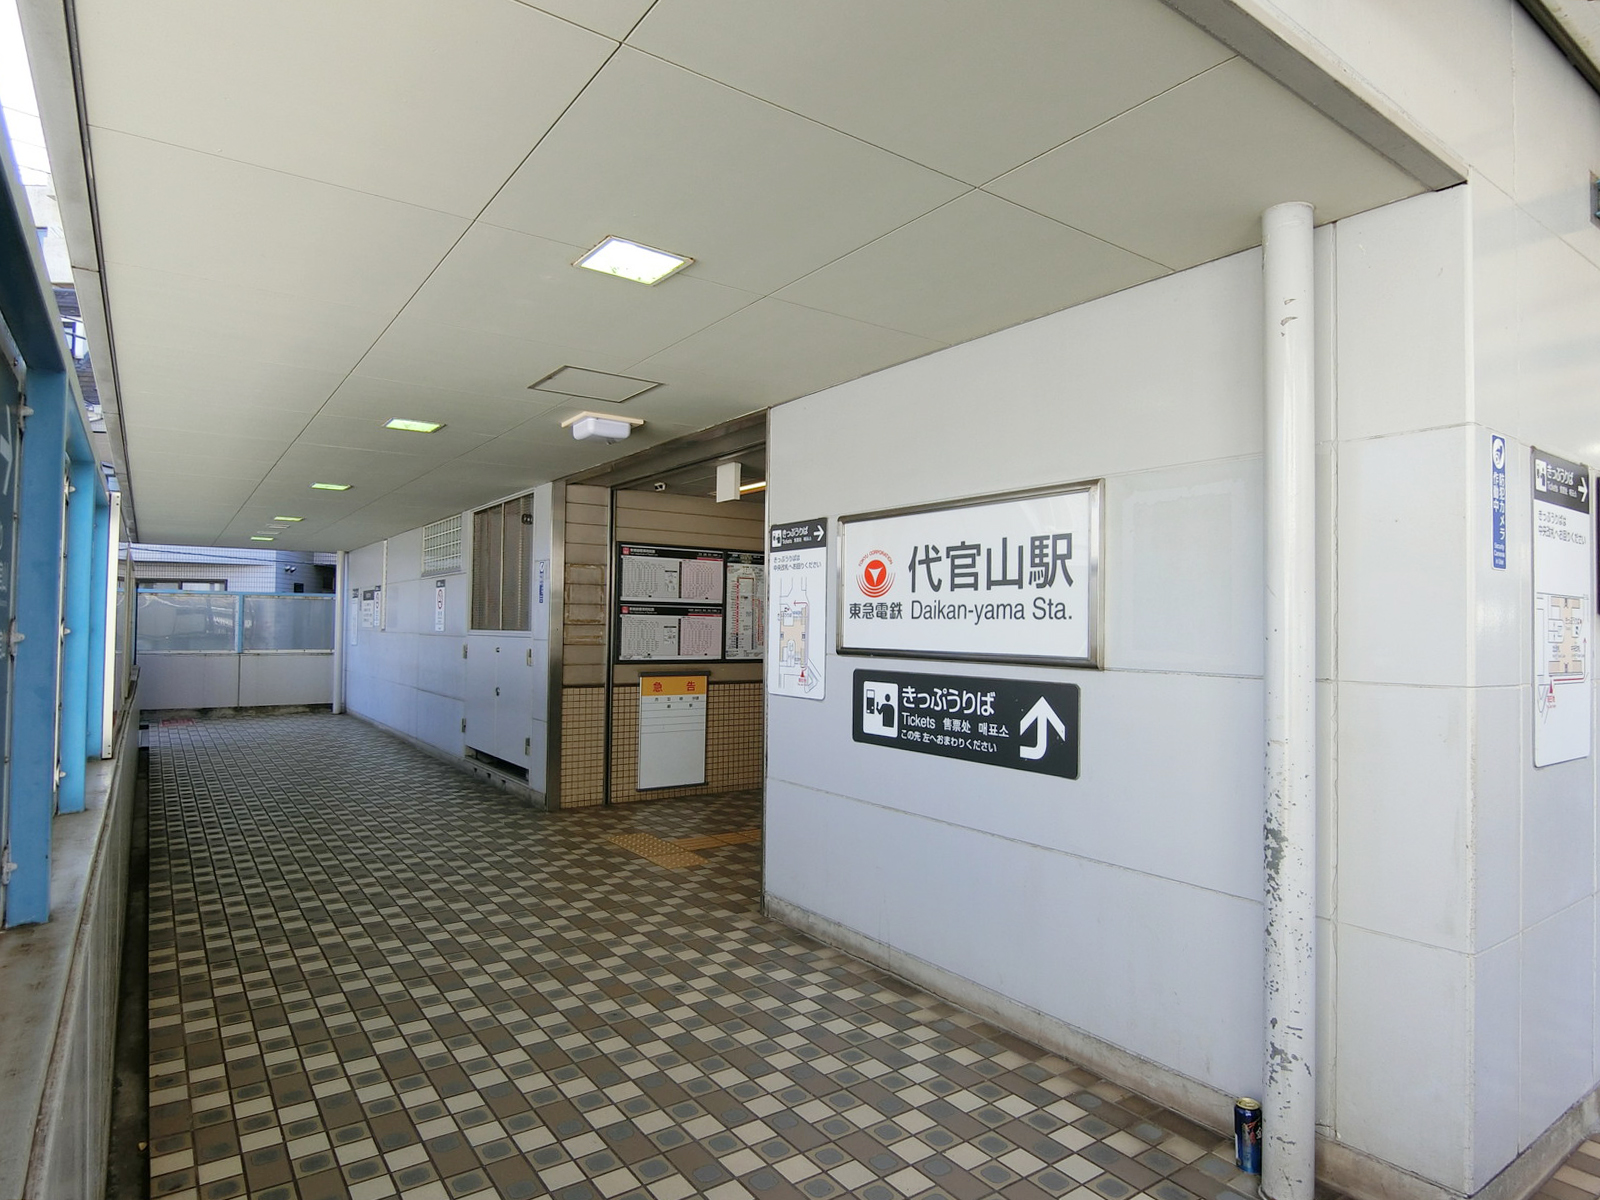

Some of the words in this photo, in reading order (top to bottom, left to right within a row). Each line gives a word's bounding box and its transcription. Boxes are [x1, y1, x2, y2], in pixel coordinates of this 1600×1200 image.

[1547, 464, 1574, 486] きっぷうりば
[782, 526, 809, 538] きっぷうりば
[908, 533, 1074, 593] 代官山駅
[849, 601, 903, 620] 東急電鉄
[911, 599, 1025, 625] Daikan-yama
[1032, 596, 1073, 621] Sta.
[901, 685, 996, 716] きっぷうりば
[901, 712, 936, 729] Tickets
[978, 722, 1010, 738] 매표소
